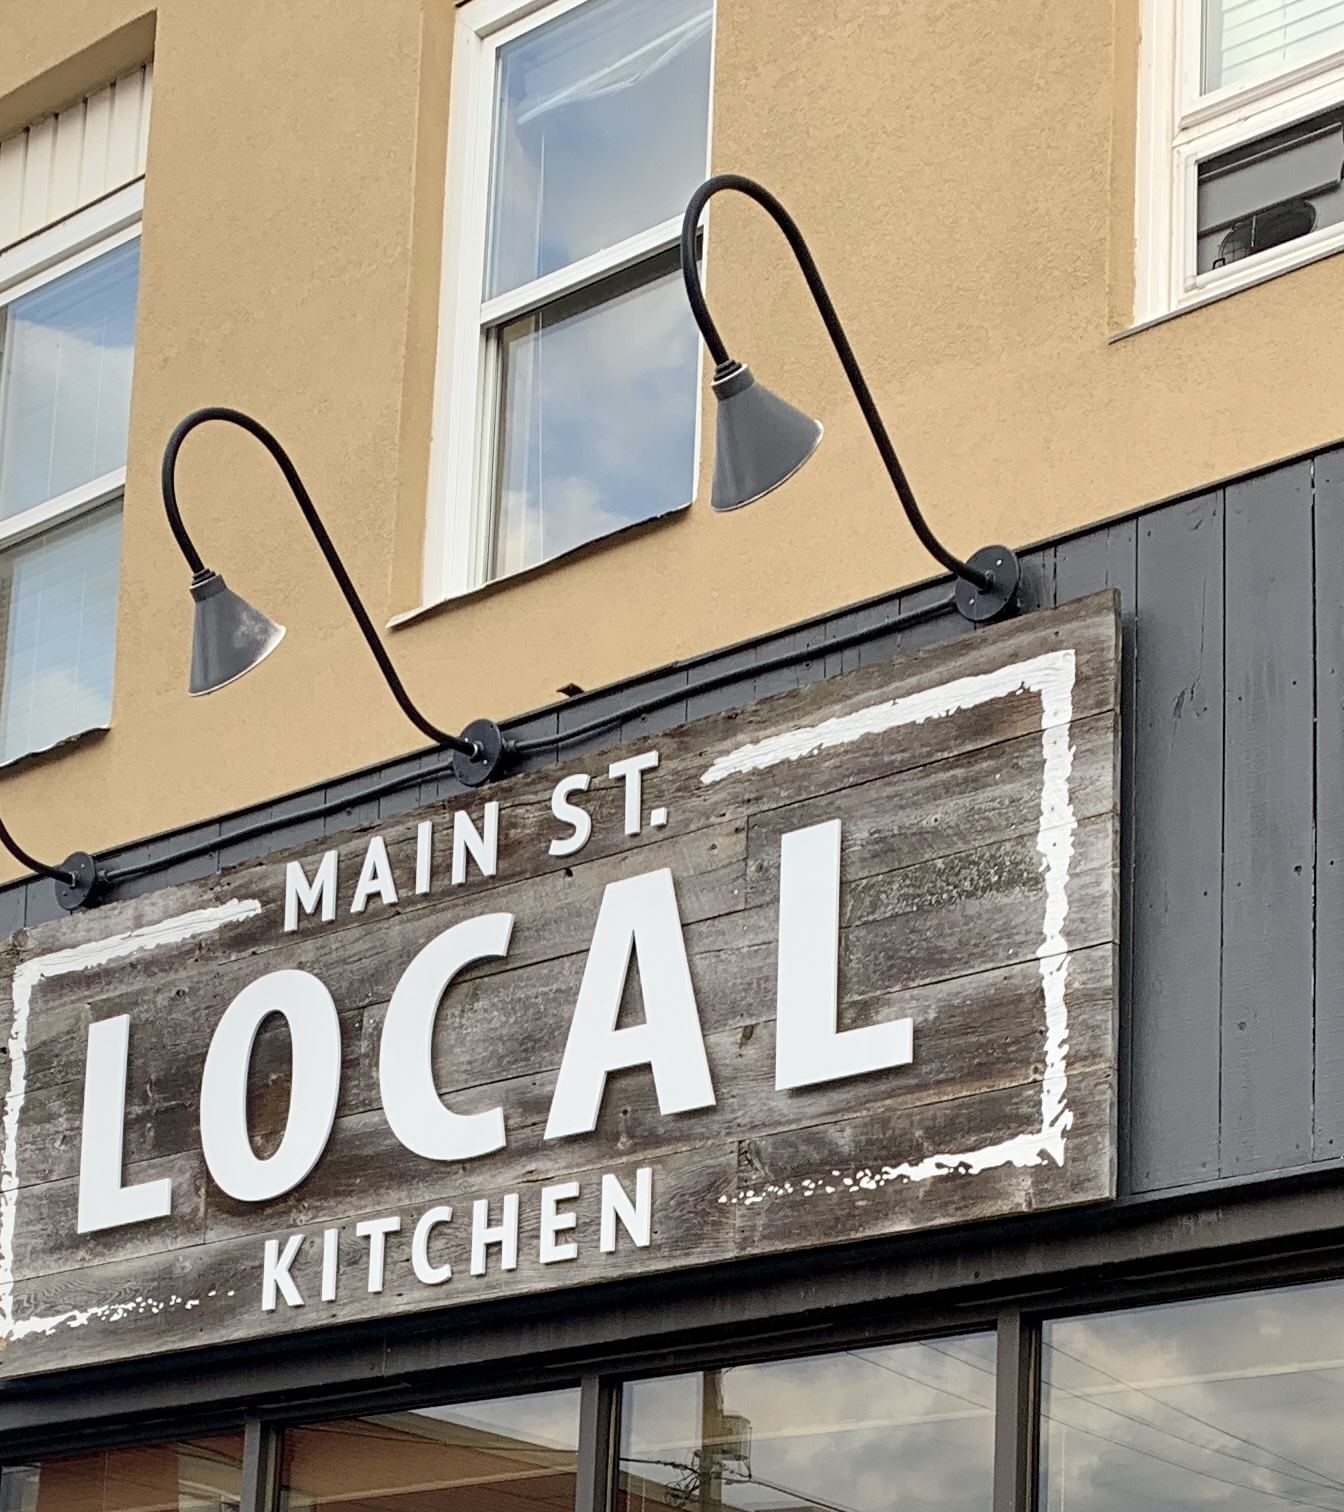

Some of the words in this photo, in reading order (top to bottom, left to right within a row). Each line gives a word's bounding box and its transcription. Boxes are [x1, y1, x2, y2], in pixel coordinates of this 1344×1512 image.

[284, 801, 499, 932] MAIN
[548, 750, 667, 855] ST.
[76, 818, 914, 1235] LOCAL
[261, 1166, 653, 1311] KITCHEN
